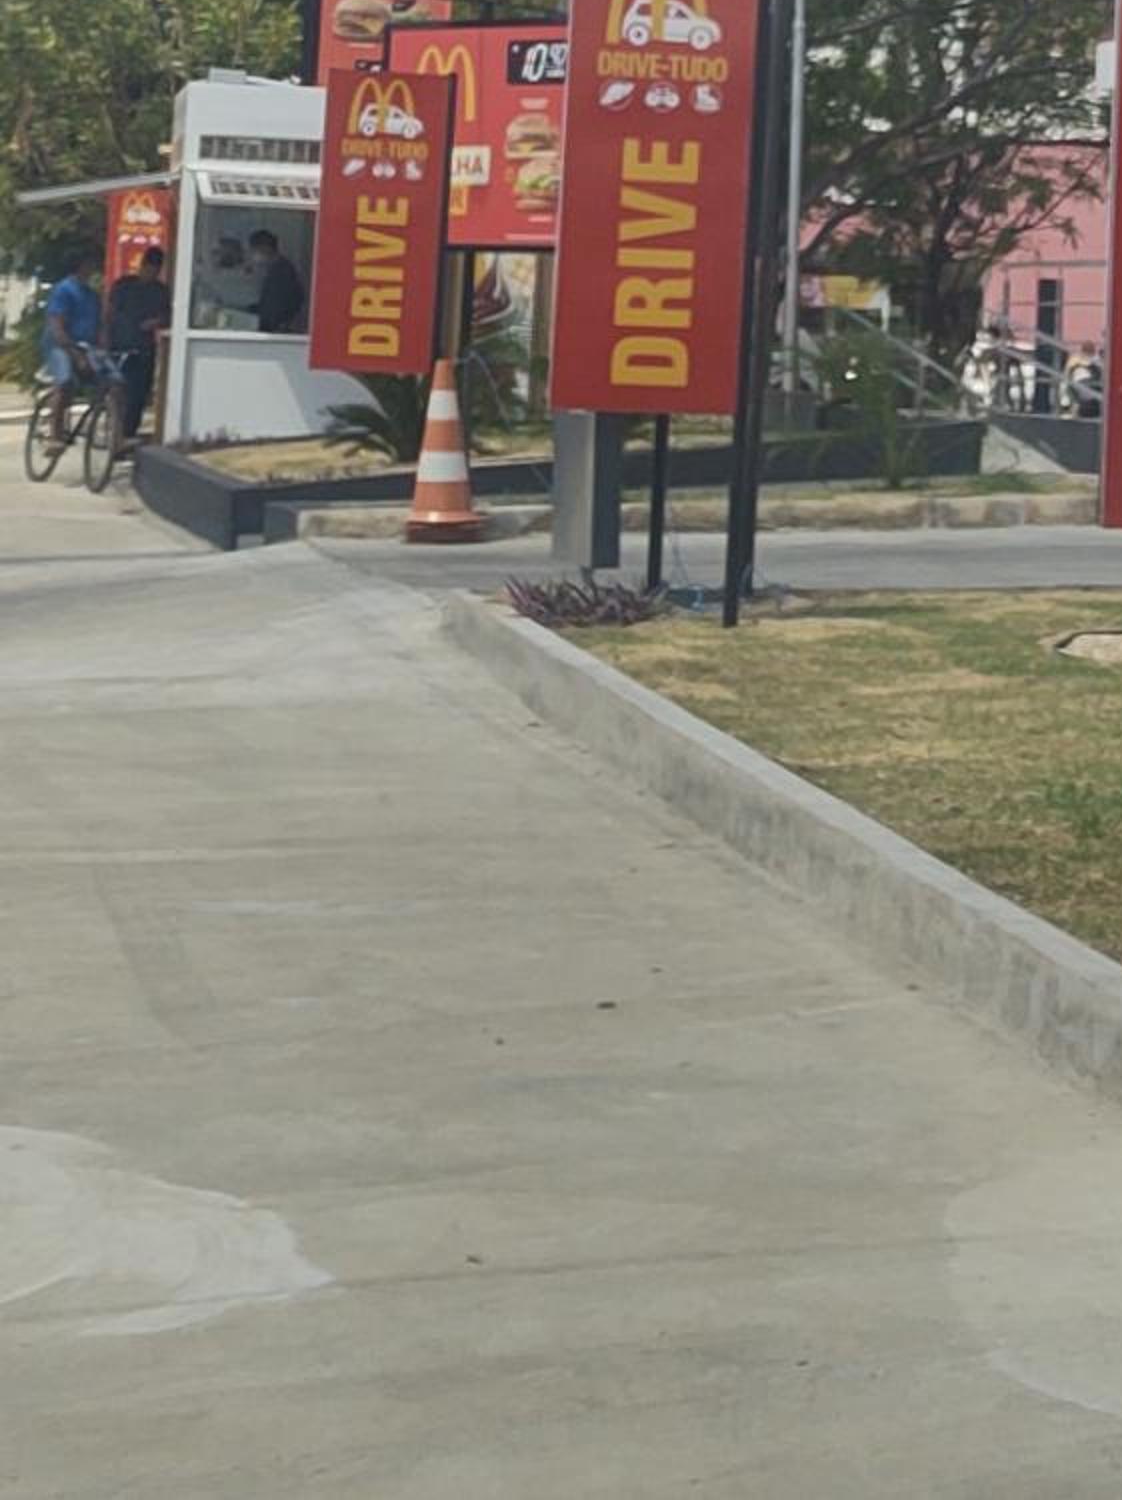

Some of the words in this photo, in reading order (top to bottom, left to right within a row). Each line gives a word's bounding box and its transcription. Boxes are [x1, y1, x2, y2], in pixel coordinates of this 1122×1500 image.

[597, 50, 728, 83] DRIVE-TUDO
[347, 195, 409, 357] DRIVE
[610, 137, 701, 388] DRIVE
